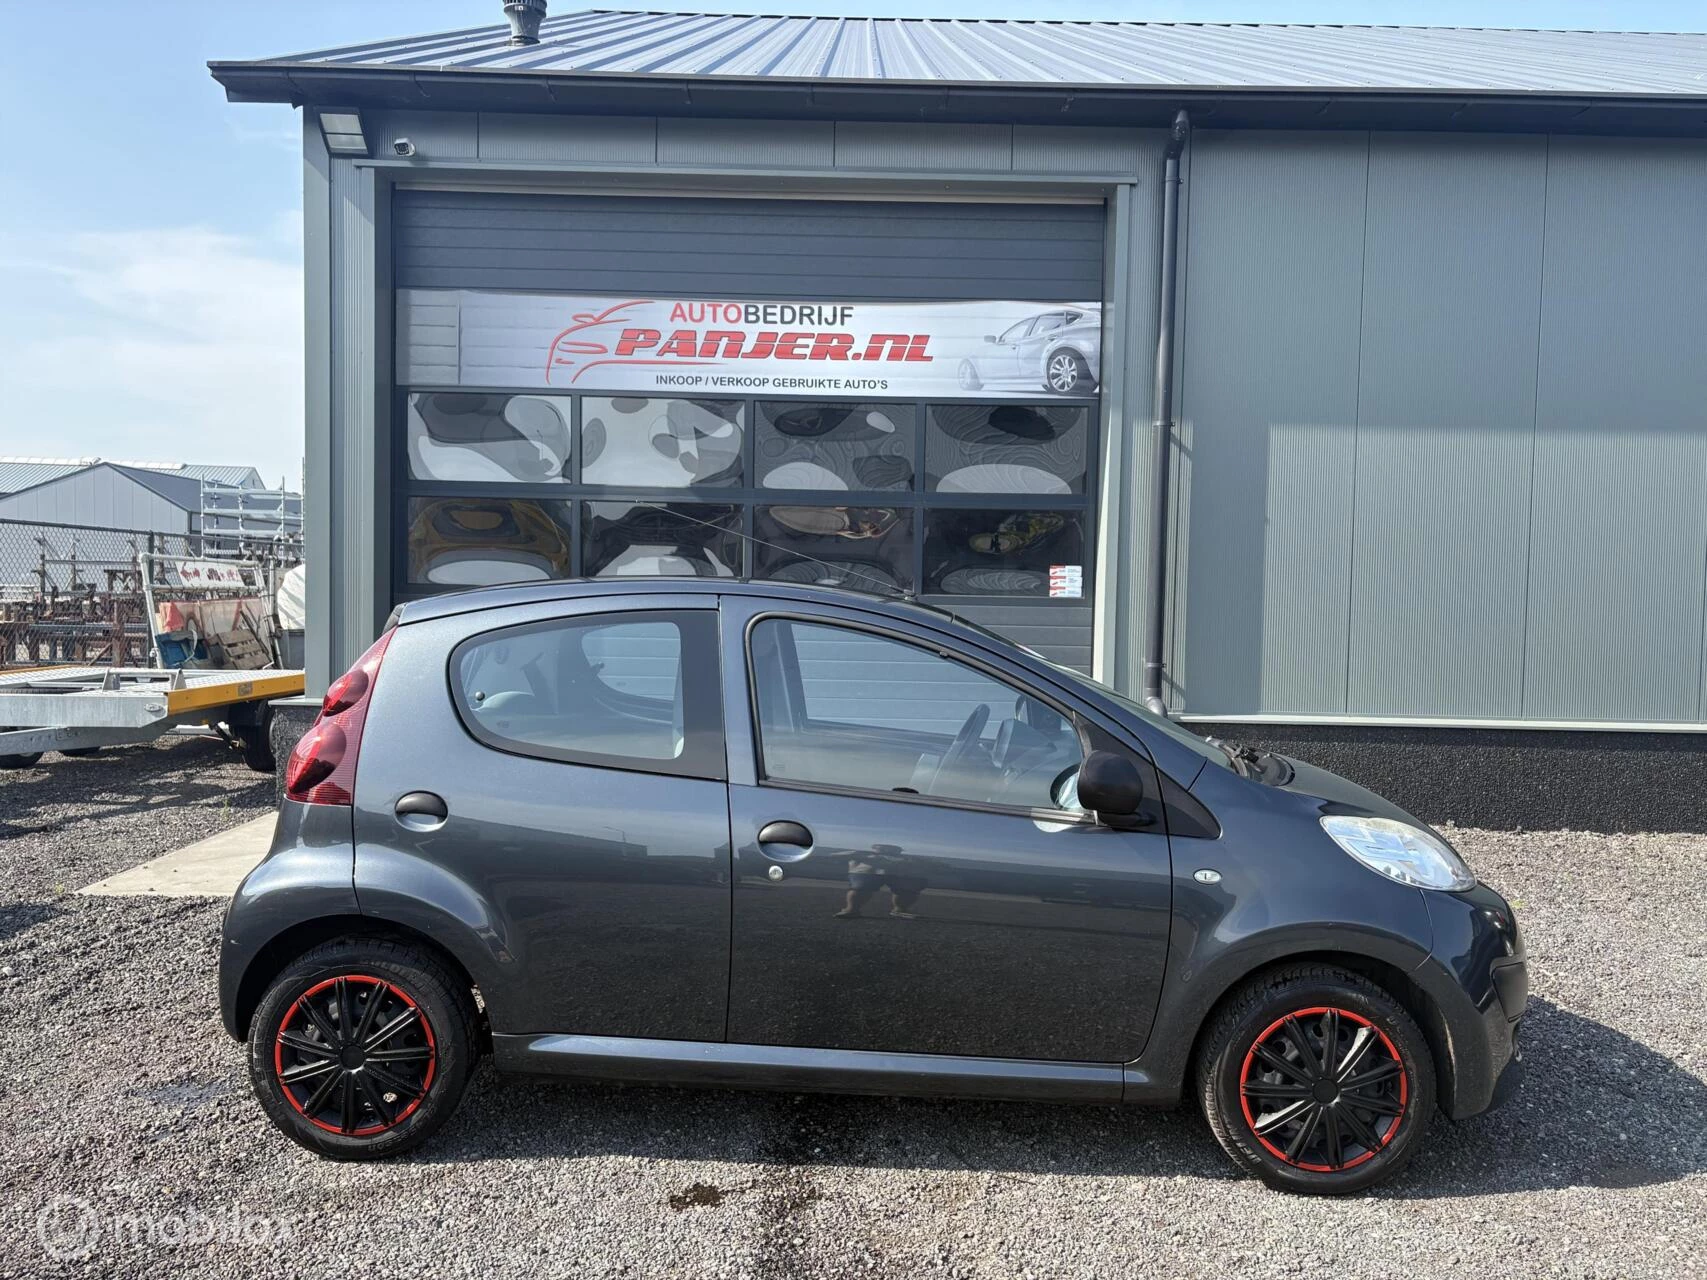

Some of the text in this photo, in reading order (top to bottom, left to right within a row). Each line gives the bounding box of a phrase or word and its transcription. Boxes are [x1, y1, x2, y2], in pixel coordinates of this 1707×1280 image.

[669, 302, 854, 326] AUTOBEDRIJF
[614, 328, 934, 362] PANJER.NL
[656, 375, 702, 386] INKOOP
[711, 376, 770, 388] VERKOOP
[772, 378, 841, 389] GEBRUIKTE
[843, 379, 888, 390] AUTO'S
